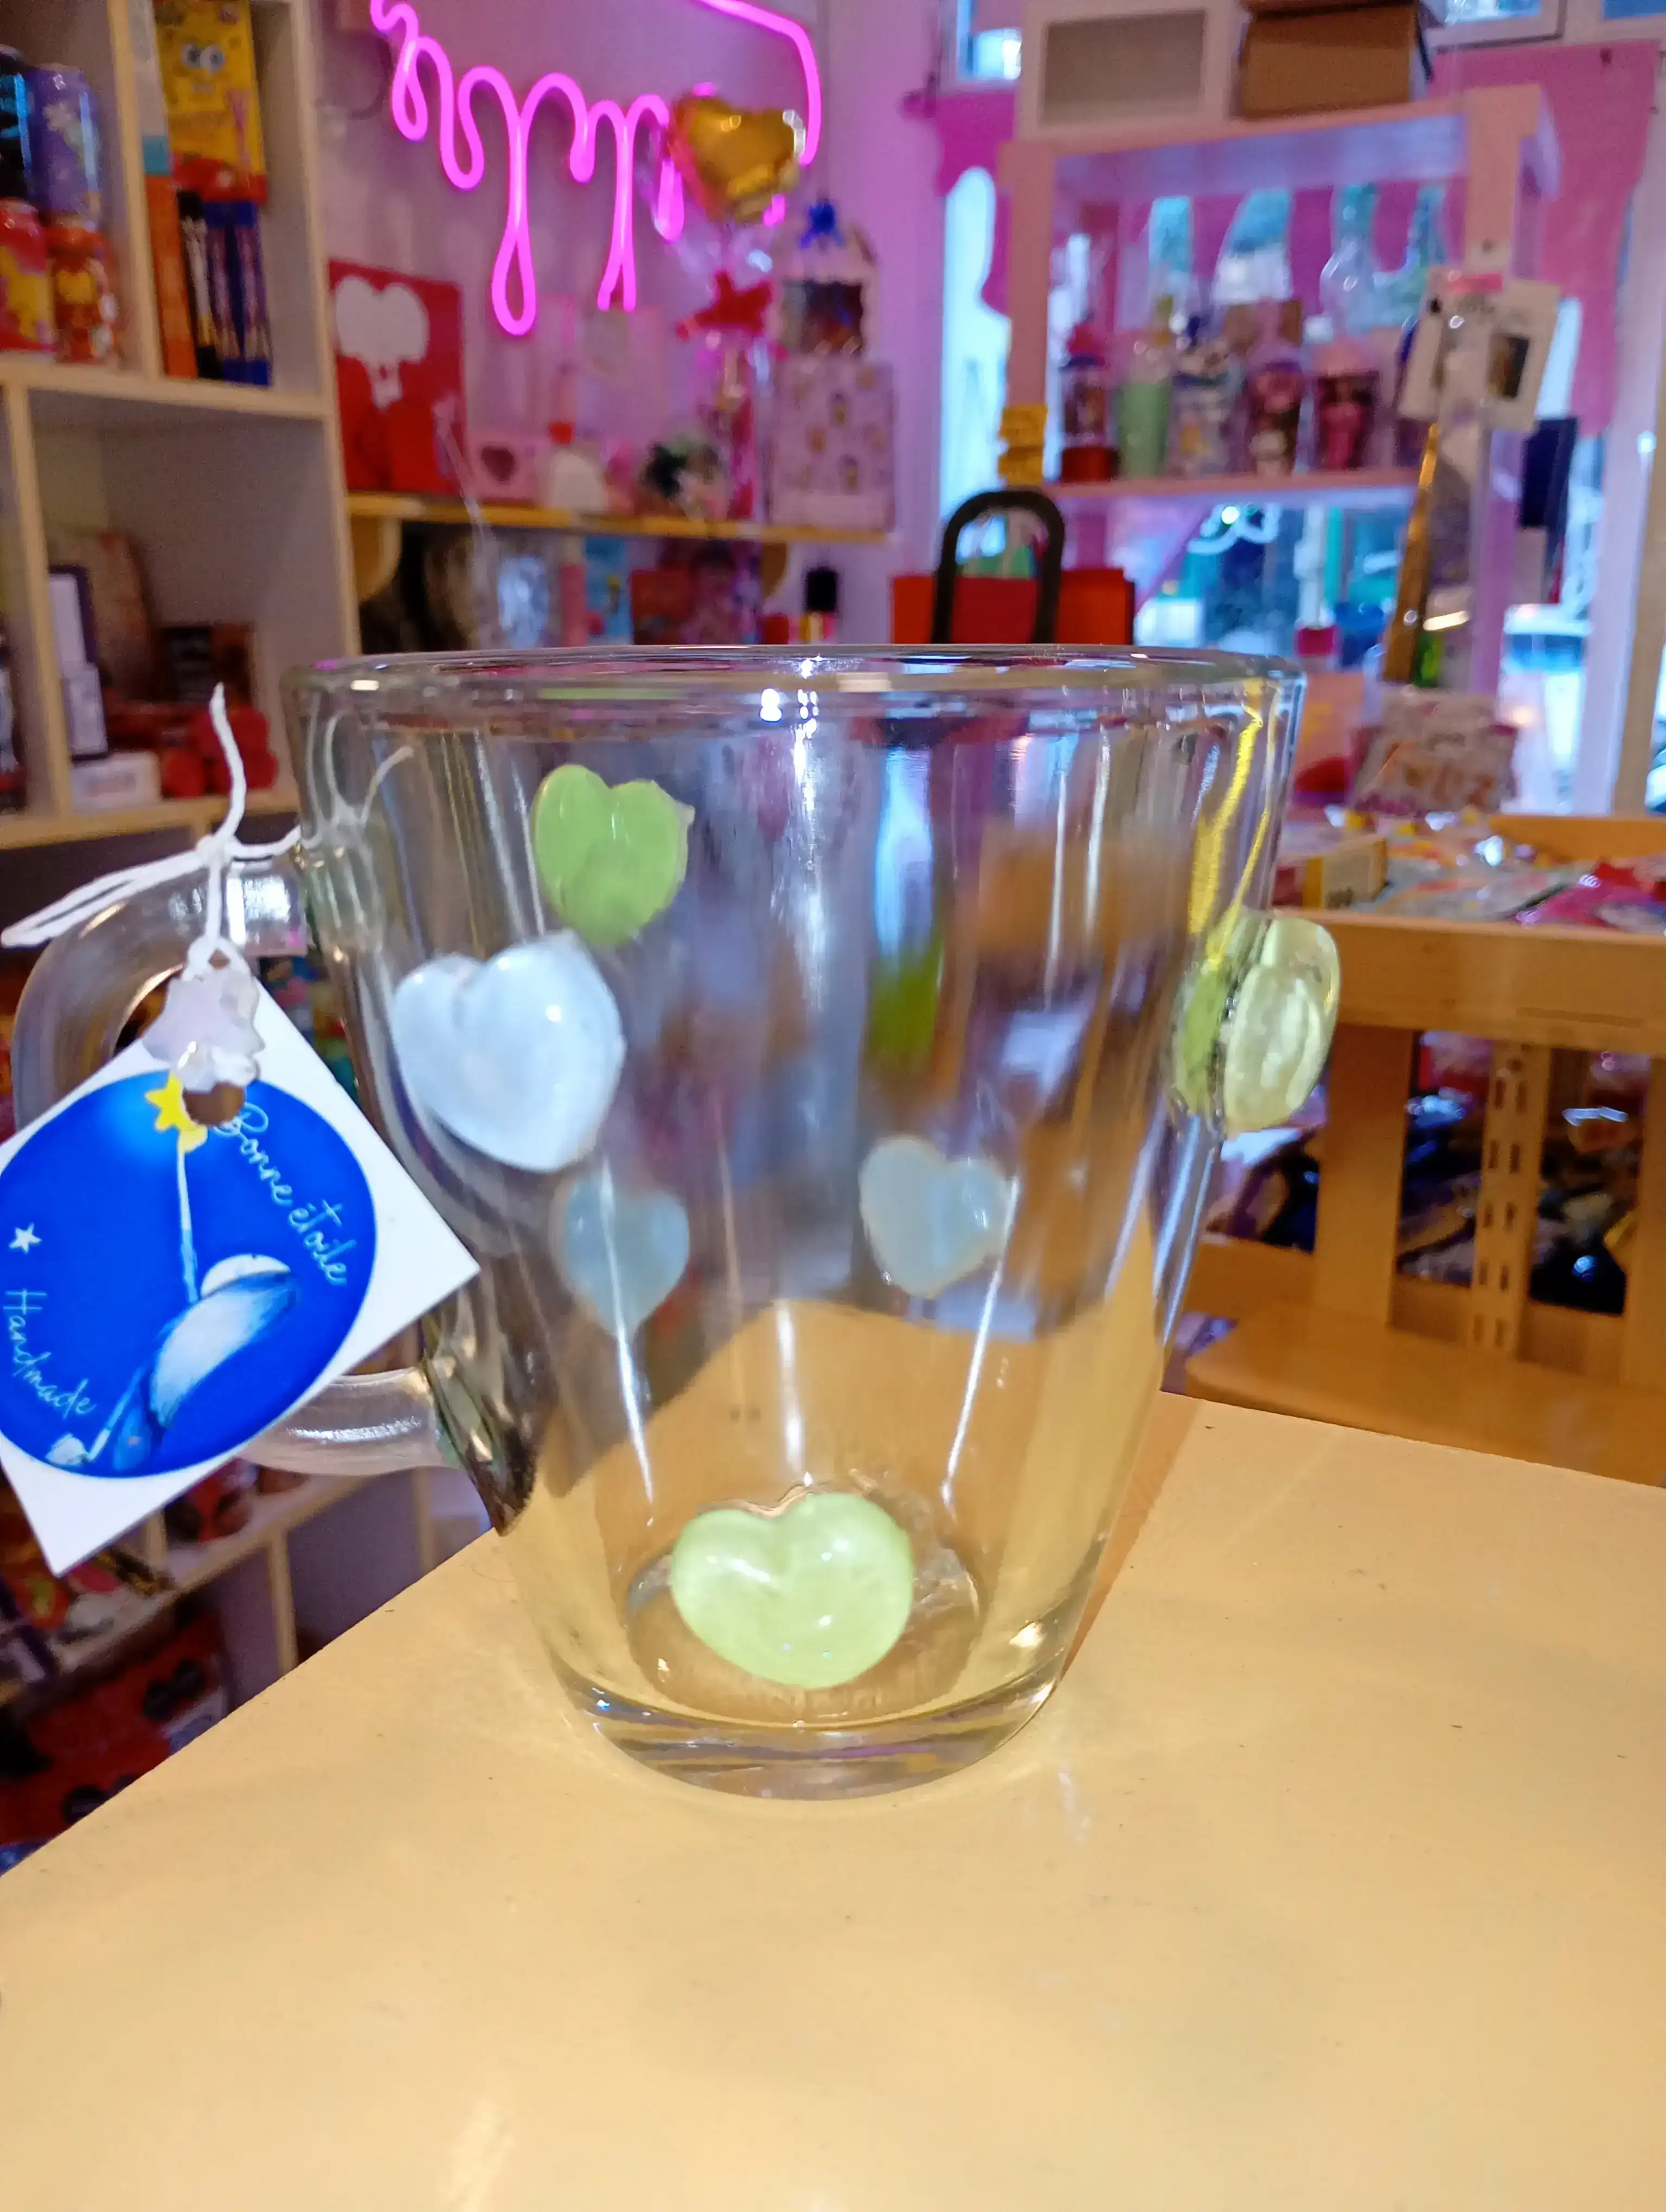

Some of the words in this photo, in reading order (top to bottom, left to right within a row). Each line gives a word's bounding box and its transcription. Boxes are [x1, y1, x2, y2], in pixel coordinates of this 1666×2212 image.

[213, 1102, 293, 1207] Bonne
[289, 1198, 356, 1285] étoile
[3, 1288, 98, 1419] Handmade
